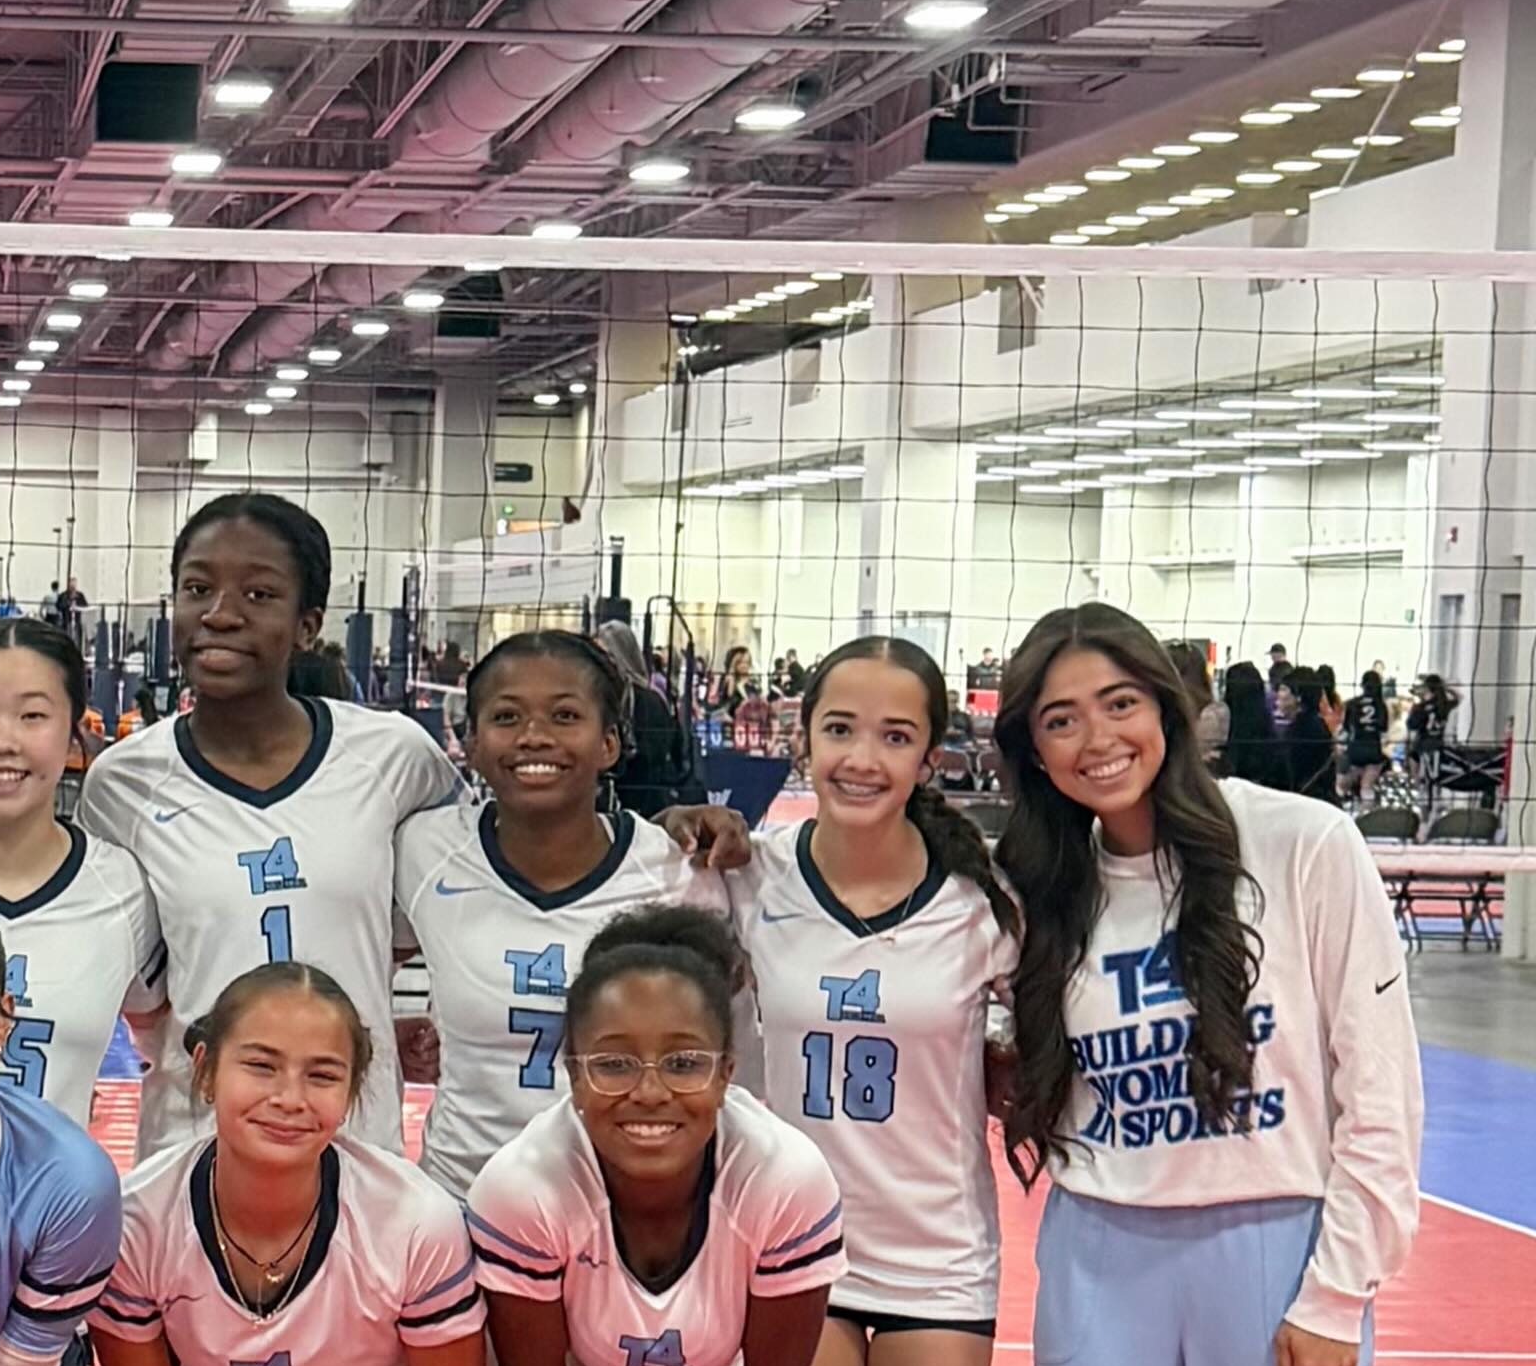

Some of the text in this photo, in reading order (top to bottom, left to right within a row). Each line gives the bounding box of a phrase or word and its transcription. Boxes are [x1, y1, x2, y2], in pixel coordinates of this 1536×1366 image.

[237, 836, 299, 895] T4
[260, 905, 293, 963] 1
[504, 943, 567, 995] T4
[820, 969, 882, 1021] T4
[508, 1006, 566, 1090] 7
[1069, 1003, 1276, 1073] BUILDG
[802, 1031, 899, 1123] 18
